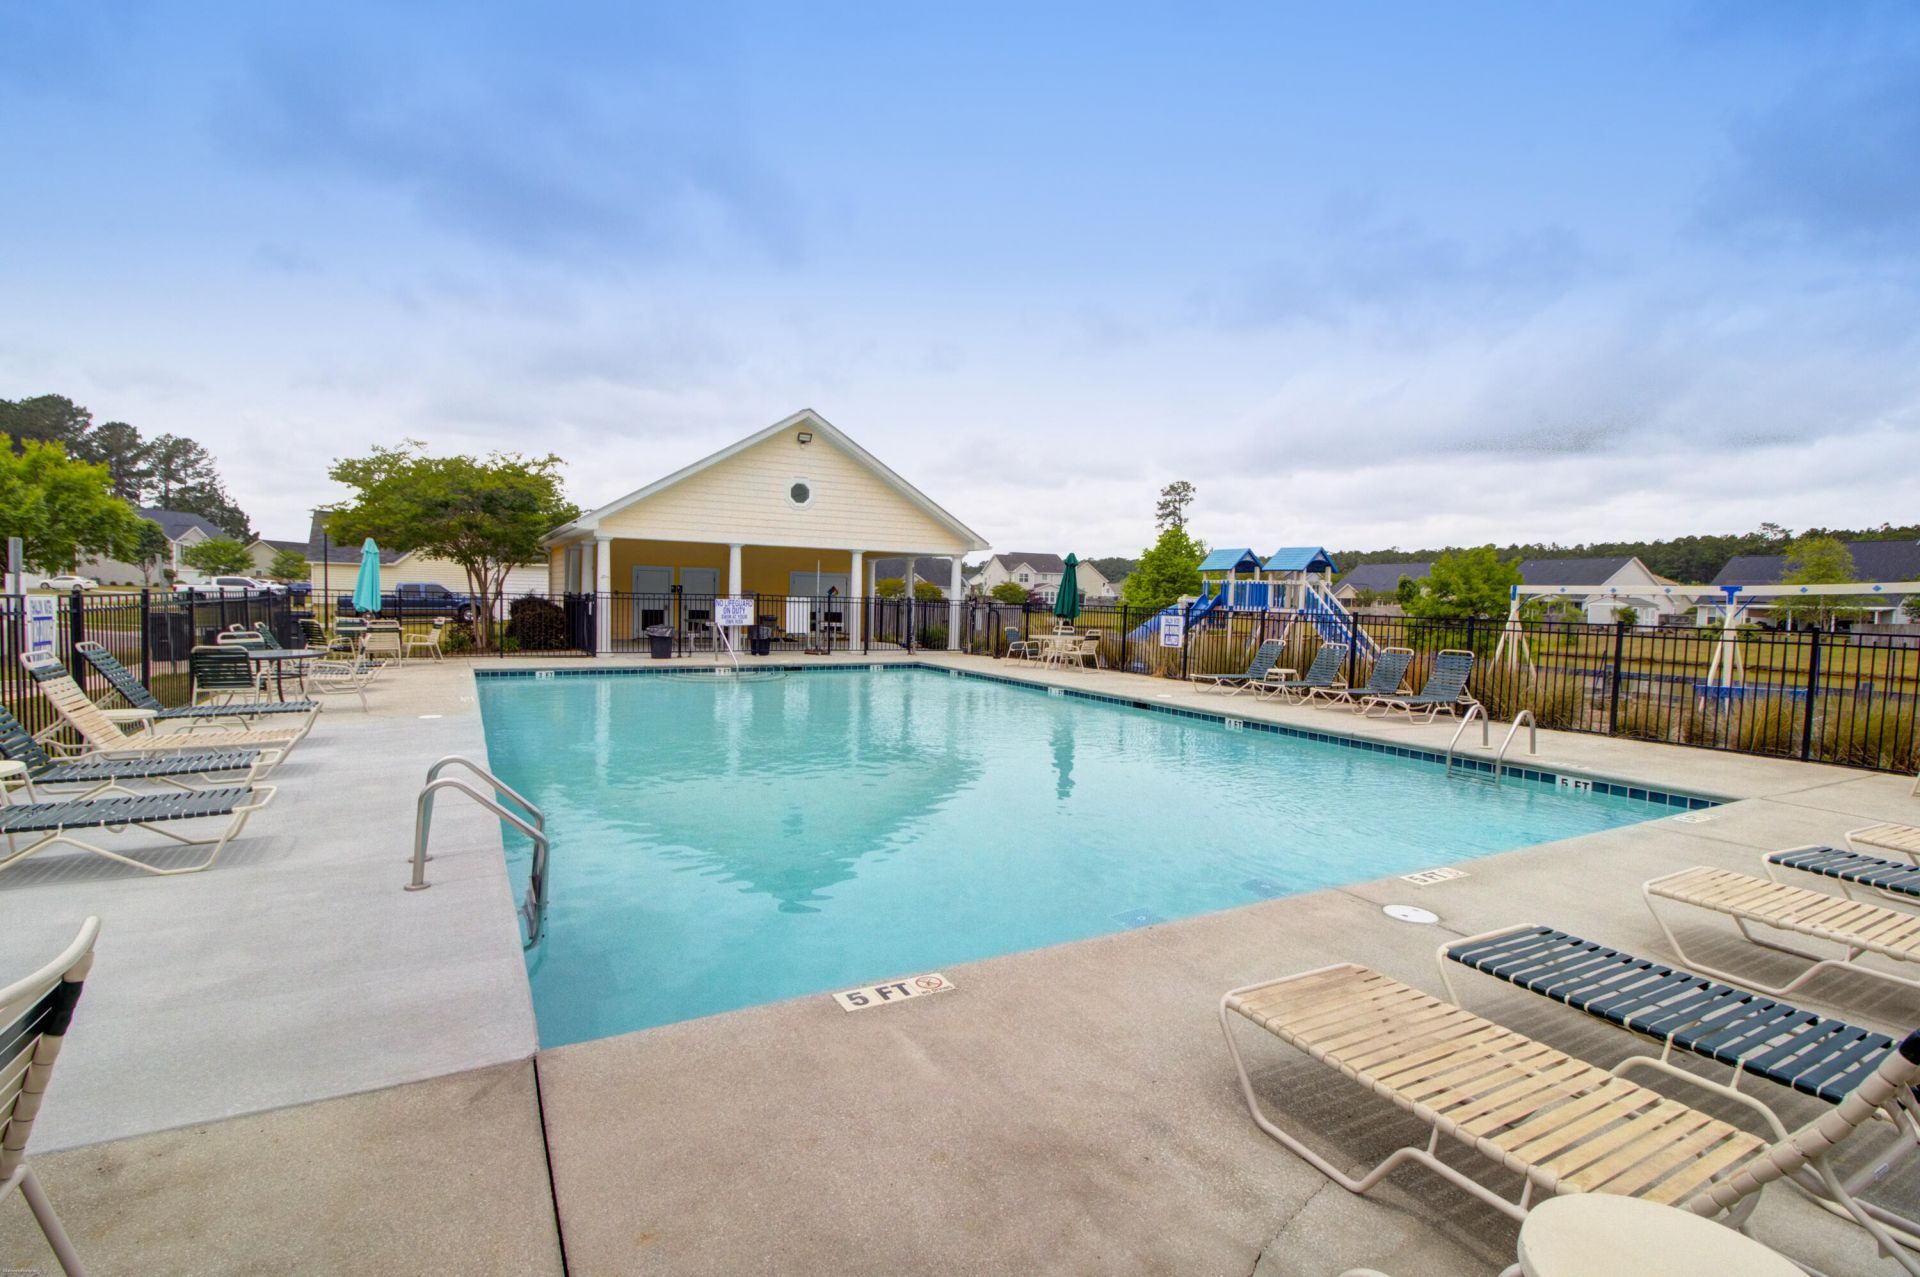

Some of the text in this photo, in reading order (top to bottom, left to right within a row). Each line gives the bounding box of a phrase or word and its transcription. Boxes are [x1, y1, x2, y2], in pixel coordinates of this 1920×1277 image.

[715, 599, 753, 607] NO LIFEGUARD
[723, 606, 745, 614] ON DUTY
[1561, 778, 1590, 790] 5 FT
[1421, 872, 1448, 880] FT
[846, 982, 912, 1006] 5 FT
